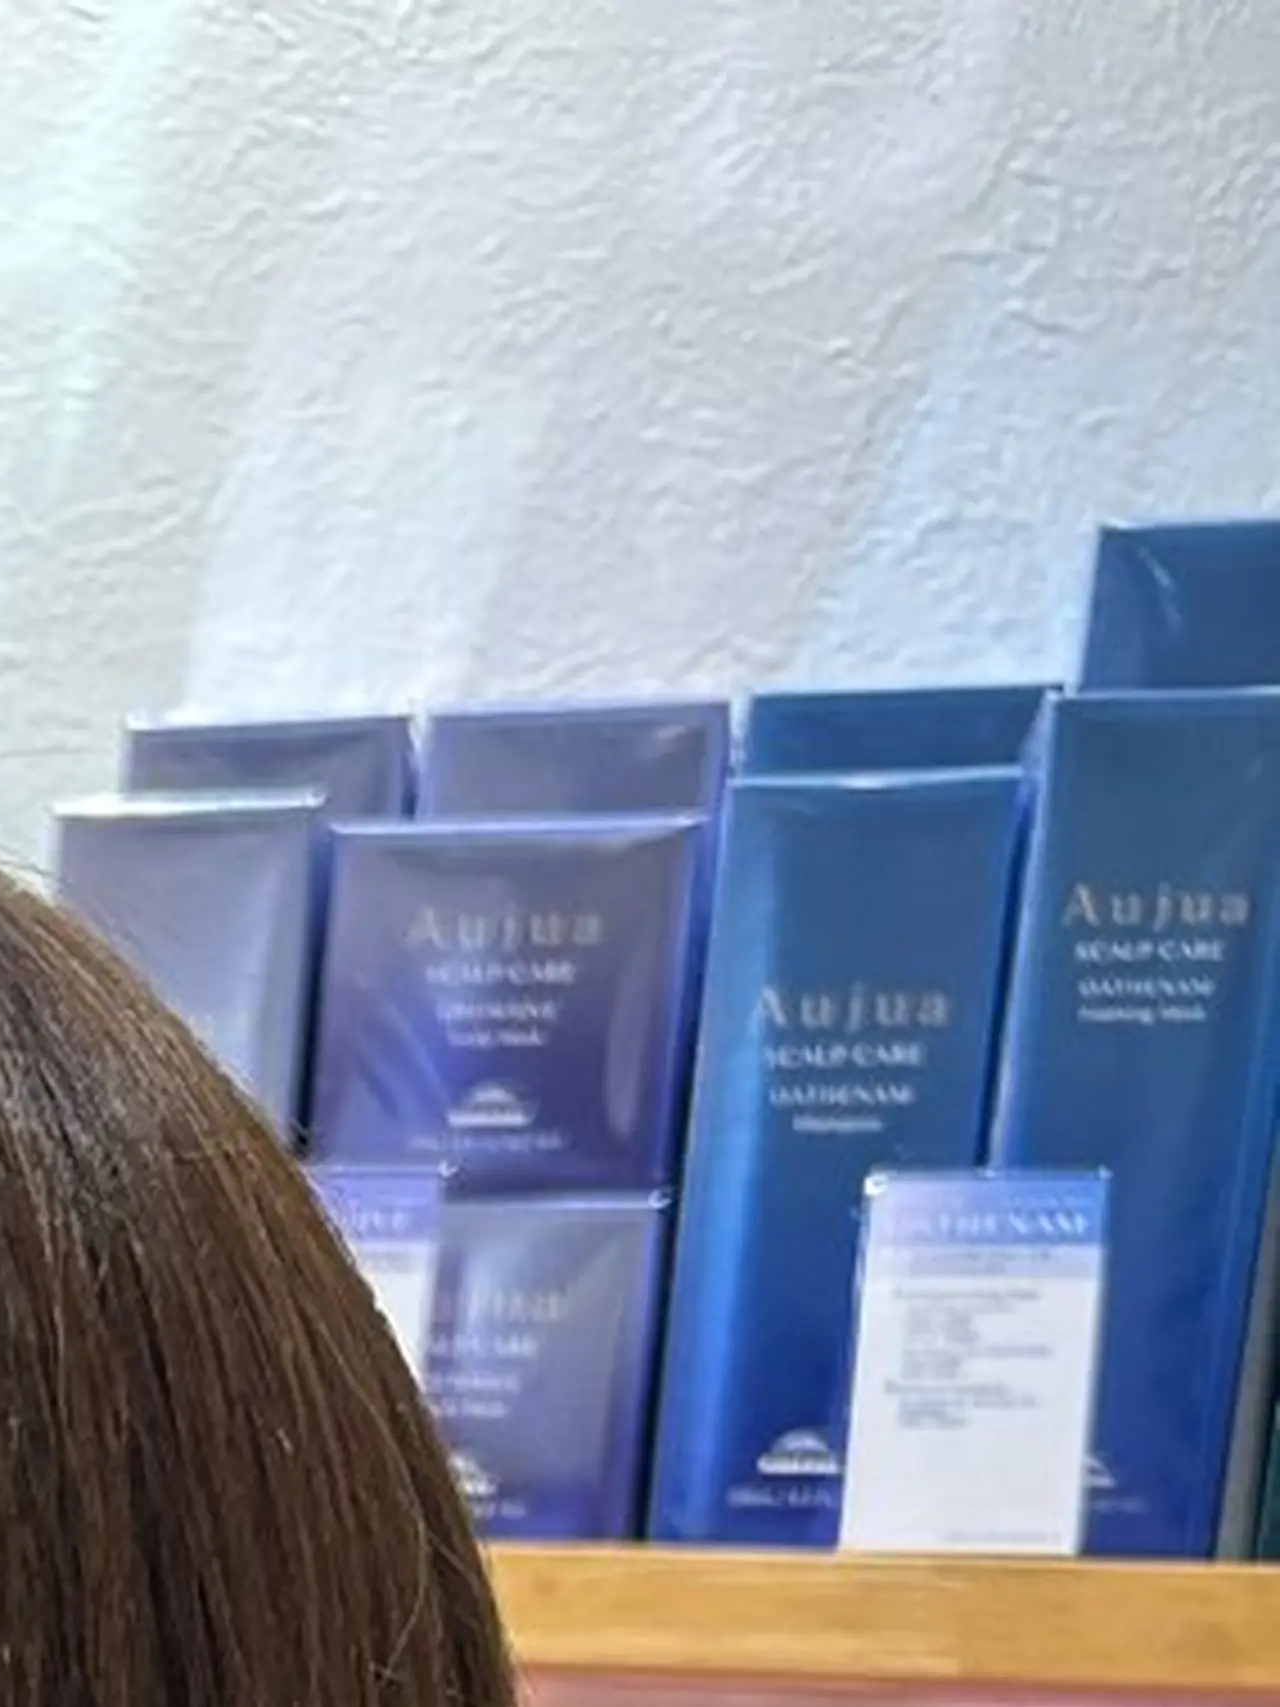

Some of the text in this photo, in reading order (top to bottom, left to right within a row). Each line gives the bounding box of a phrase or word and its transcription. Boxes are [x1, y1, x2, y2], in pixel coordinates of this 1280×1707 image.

[402, 905, 604, 952] Aujua
[1061, 882, 1249, 933] Aujua
[1158, 938, 1224, 963] CARE
[746, 980, 950, 1035] Aujua
